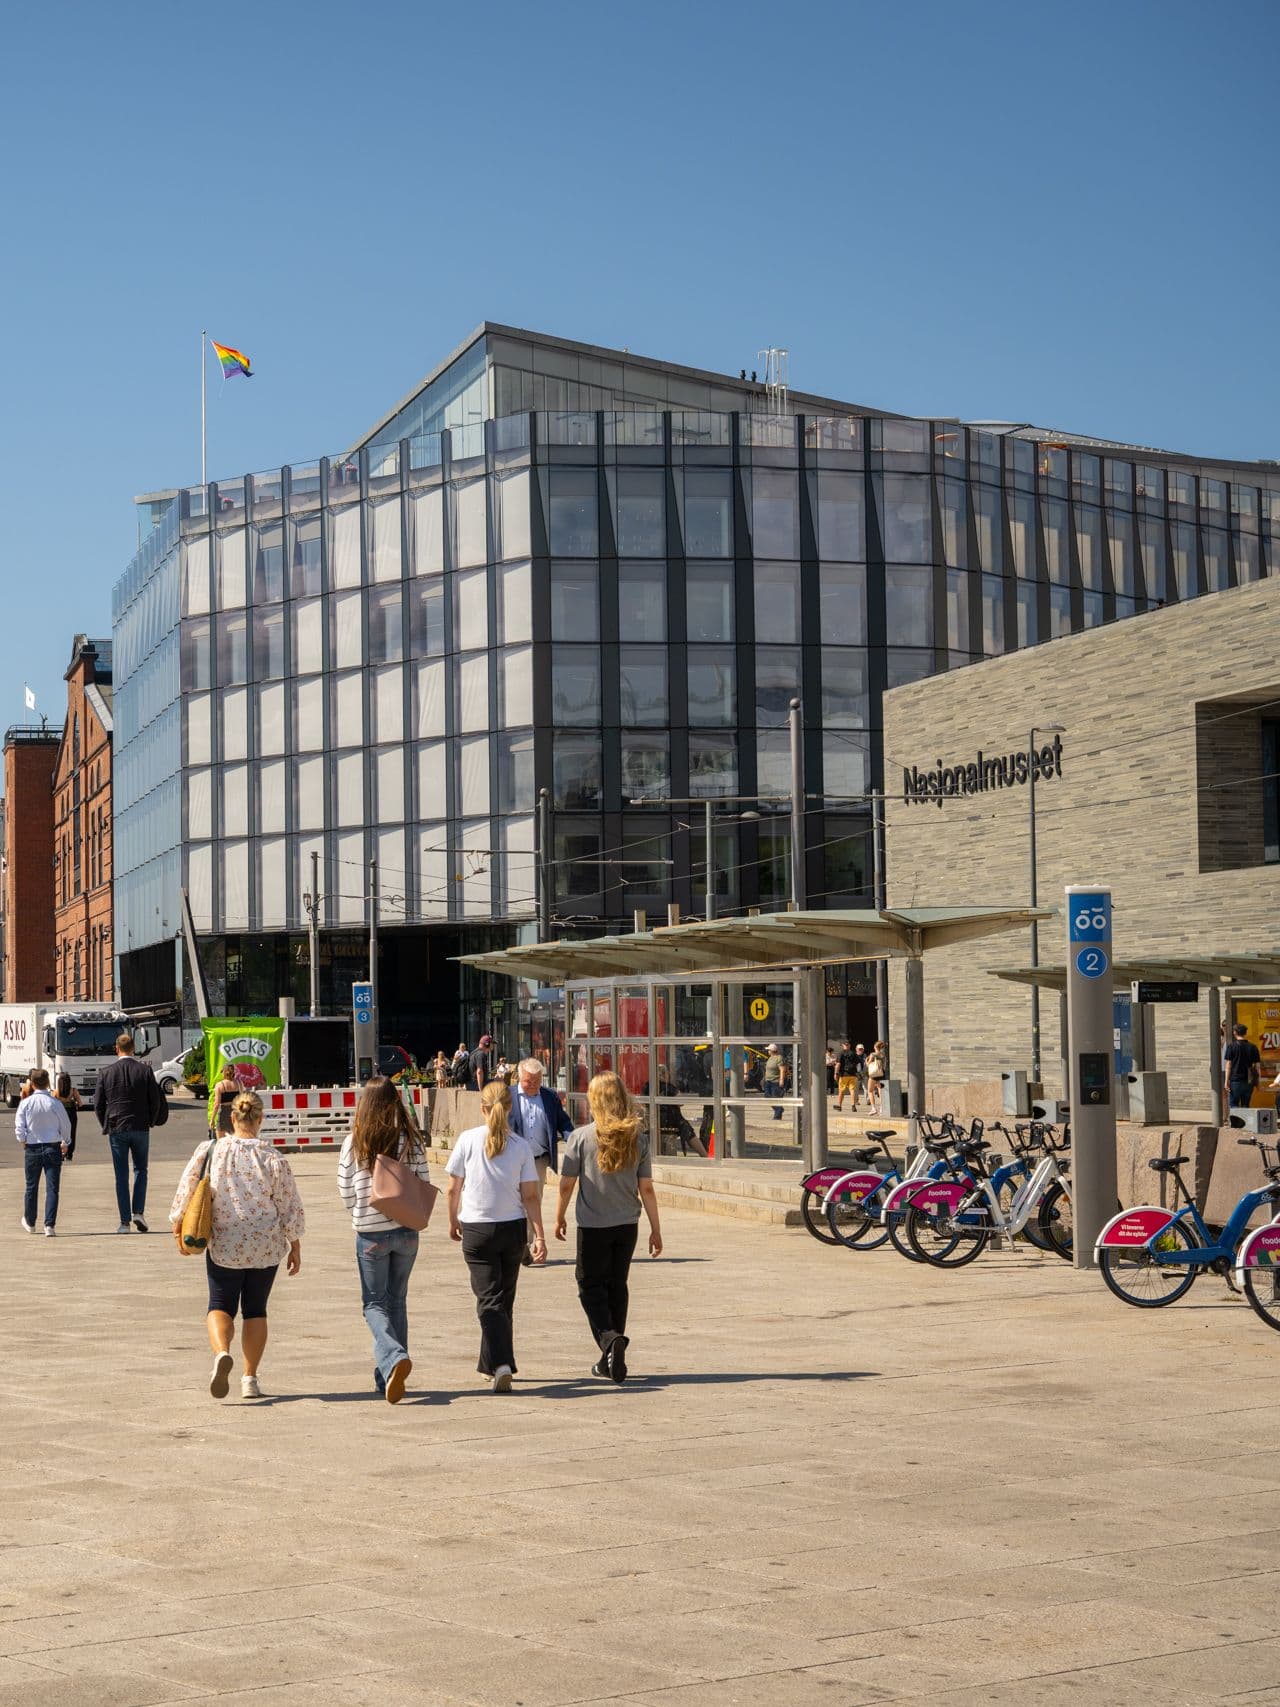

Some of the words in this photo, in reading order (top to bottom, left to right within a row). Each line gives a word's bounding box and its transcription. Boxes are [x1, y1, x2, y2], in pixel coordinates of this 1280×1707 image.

[903, 733, 1064, 810] Nasjonalmuseet
[1086, 953, 1099, 971] 2
[755, 1002, 764, 1016] H
[3, 1019, 27, 1041] ASKO
[223, 1039, 268, 1058] PICKS
[1261, 1237, 1280, 1245] food
